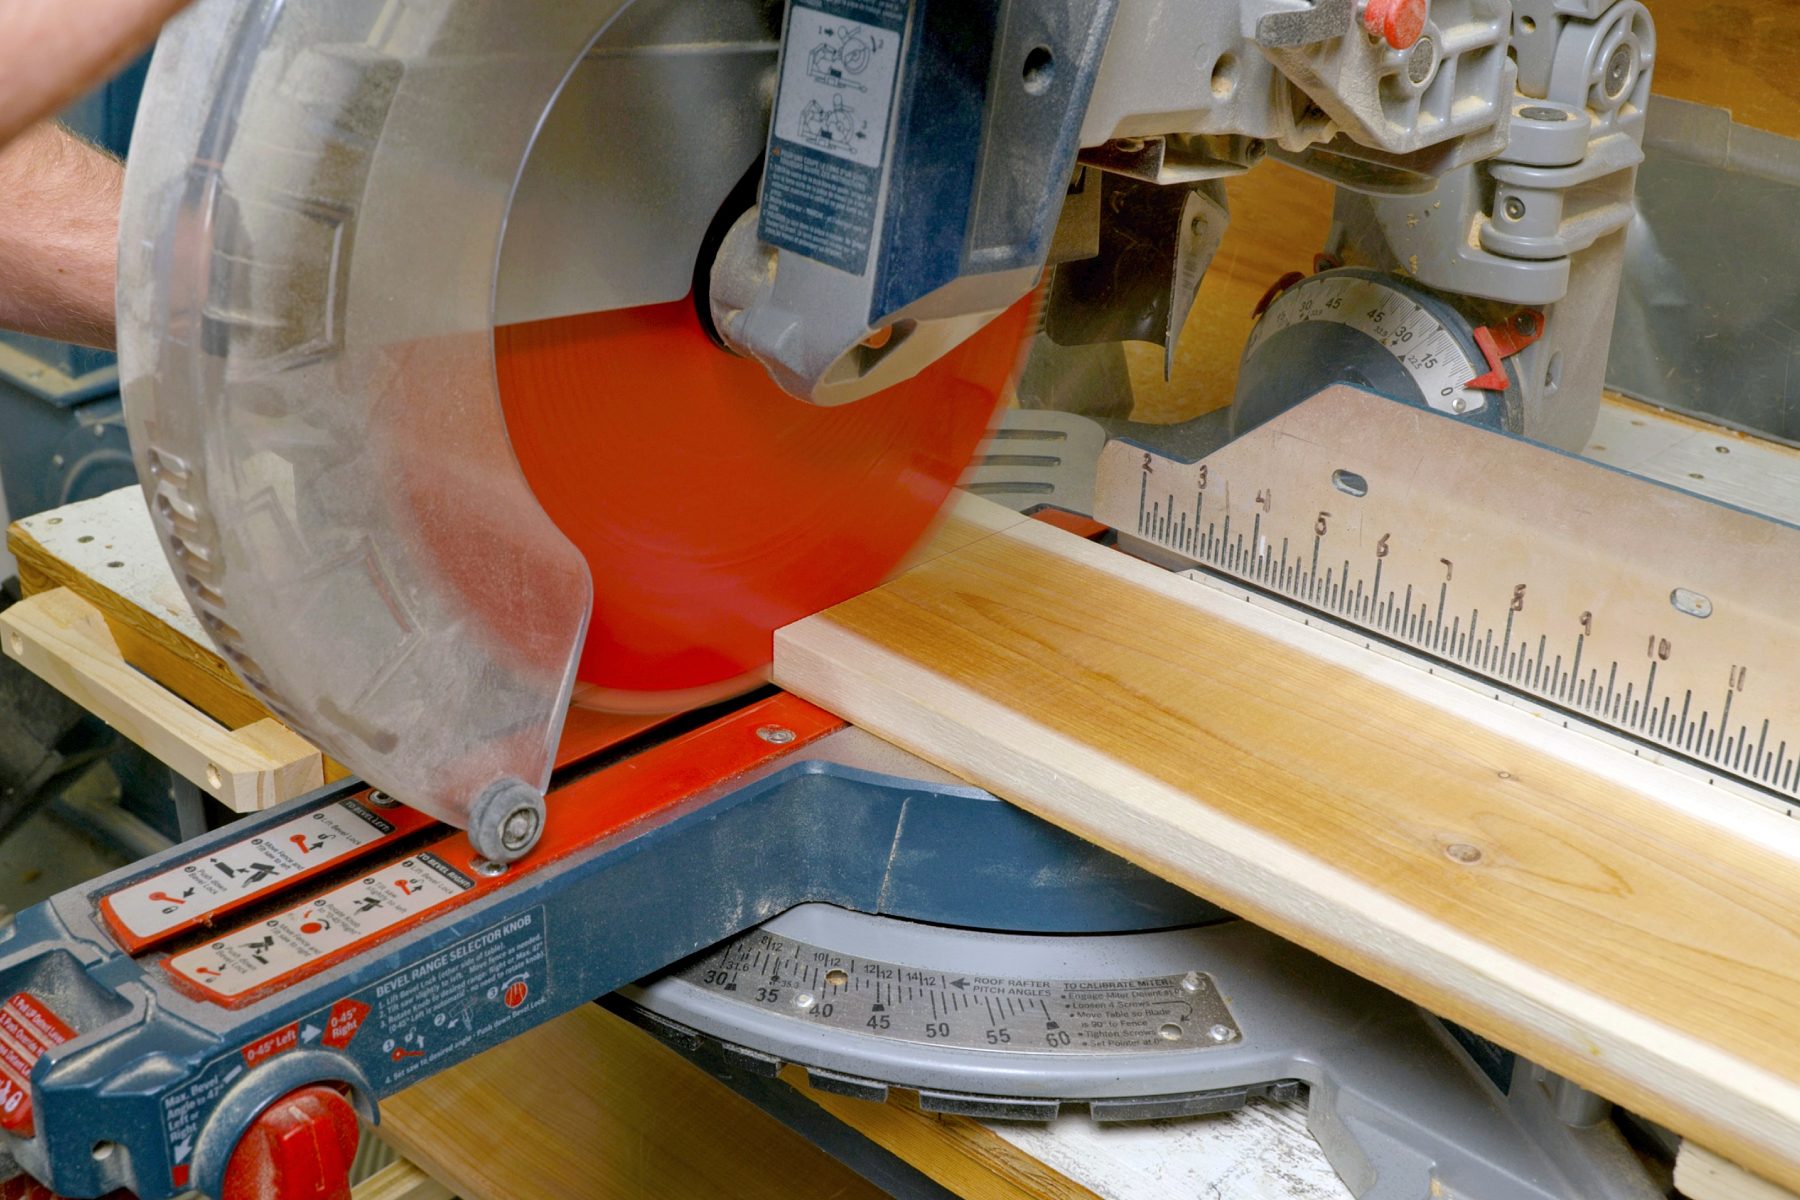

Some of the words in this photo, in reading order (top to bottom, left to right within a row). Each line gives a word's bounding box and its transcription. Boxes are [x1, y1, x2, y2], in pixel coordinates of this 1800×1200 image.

[1298, 300, 1313, 312] 30
[1325, 298, 1343, 310] 45
[1367, 309, 1385, 323] 45
[1395, 326, 1413, 342] 30
[1407, 355, 1422, 370] 22.5
[1421, 353, 1438, 369] 15
[1440, 387, 1454, 397] 0
[1142, 453, 1153, 473] 2
[1198, 464, 1208, 489] 3
[1256, 488, 1272, 513] 4
[1315, 511, 1332, 536] 5
[1376, 533, 1391, 558] 6
[1440, 558, 1453, 582] 7
[1511, 583, 1527, 612] 8
[1579, 611, 1593, 636] 9
[1647, 635, 1672, 661] 10
[1729, 664, 1747, 692] 11
[346, 800, 354, 809] TO
[354, 805, 373, 822] BEVEL
[372, 817, 390, 832] LEFT
[331, 824, 349, 836] Bevel
[346, 835, 362, 846] Lock
[263, 841, 278, 852] Move
[279, 850, 294, 863] Fence
[419, 852, 430, 861] TO
[428, 858, 449, 874] BEVEL
[448, 872, 472, 889] RIGHT
[188, 872, 205, 885] Bevel
[203, 882, 218, 896] Lock
[422, 872, 440, 884] Bevel
[438, 884, 454, 894] Lock
[761, 936, 769, 945] 8
[771, 942, 783, 952] 12
[376, 974, 410, 998] BEVEL
[412, 954, 448, 980] RANGE
[449, 928, 502, 962] SELECTOR
[502, 914, 532, 937] KNOB
[726, 960, 750, 972] 31.6
[814, 953, 824, 962] 10
[830, 958, 840, 966] 12
[386, 994, 398, 1006] Lift
[400, 984, 420, 998] Bevel
[420, 975, 437, 988] Lock
[438, 965, 459, 978] (other
[461, 958, 474, 969] side
[476, 952, 483, 960] of
[388, 1004, 399, 1014] Tilt
[400, 998, 414, 1008] saw
[415, 985, 440, 1000] slightly
[441, 980, 448, 988] to
[469, 960, 488, 972] Move
[488, 952, 507, 964] fence
[508, 947, 516, 955] as
[704, 970, 728, 986] 30
[864, 964, 876, 974] 12
[881, 970, 894, 980] 12
[907, 972, 919, 982] 14
[923, 976, 936, 986] 12
[974, 976, 1006, 986] ROOF
[1008, 980, 1050, 988] RAFTER
[781, 980, 800, 989] 35.3
[973, 985, 1005, 994] PITCH
[1008, 988, 1052, 997] ANGLES
[1064, 982, 1077, 990] TO
[1080, 980, 1133, 990] CALIBRATE
[756, 988, 778, 1003] 35
[1069, 992, 1103, 1000] Engage
[1132, 990, 1162, 998] Detent
[1120, 1000, 1150, 1008] Screws
[330, 1007, 358, 1028] 0-45°
[809, 1003, 834, 1018] 40
[332, 1019, 358, 1039] Right
[866, 1015, 890, 1030] 45
[926, 1023, 950, 1038] 50
[393, 1069, 405, 1081] Set
[406, 1062, 420, 1074] saw
[420, 1058, 428, 1066] to
[454, 1035, 472, 1050] angle
[476, 1024, 493, 1037] Push
[493, 1015, 511, 1030] down
[512, 1005, 530, 1018] Bevel
[986, 1028, 1012, 1046] 55
[1046, 1030, 1071, 1048] 60
[1086, 1030, 1120, 1038] Tighten
[247, 1039, 274, 1060] 0-45°
[276, 1029, 296, 1047] Left
[164, 1092, 190, 1110] Max.
[190, 1074, 219, 1096] Bevel
[167, 1100, 196, 1120] Angle
[196, 1096, 206, 1106] to
[206, 1084, 224, 1099] 47°
[168, 1114, 189, 1132] Left
[189, 1111, 199, 1120] or
[169, 1122, 198, 1142] Right
